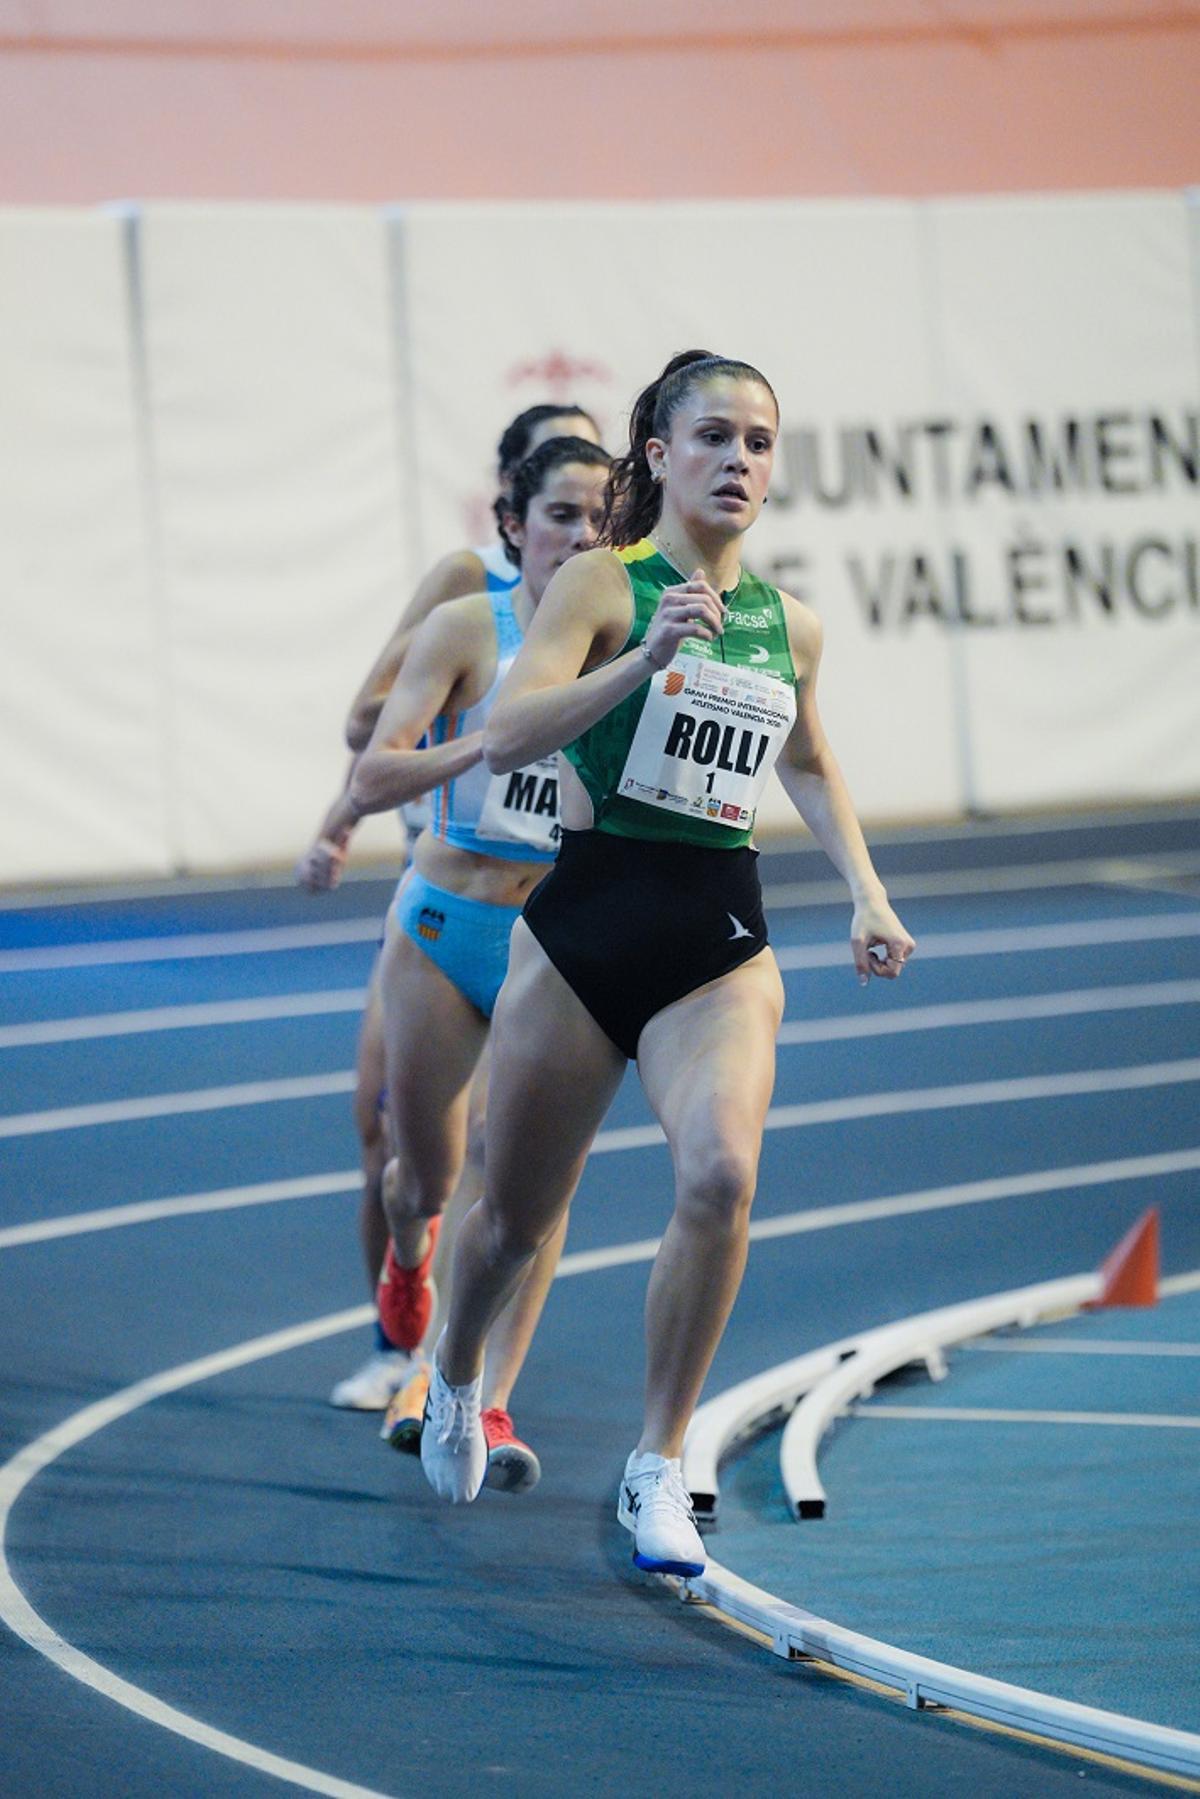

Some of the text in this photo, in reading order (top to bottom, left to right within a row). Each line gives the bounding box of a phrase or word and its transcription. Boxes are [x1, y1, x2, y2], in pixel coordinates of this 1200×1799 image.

[684, 687, 707, 699] GRAN
[709, 693, 737, 707] PREMIO
[737, 700, 790, 723] INTERNACIONAL
[691, 698, 730, 715] ATLETISMO
[731, 707, 766, 724] VALENCIA
[504, 770, 558, 818] MA
[705, 771, 716, 794] 1
